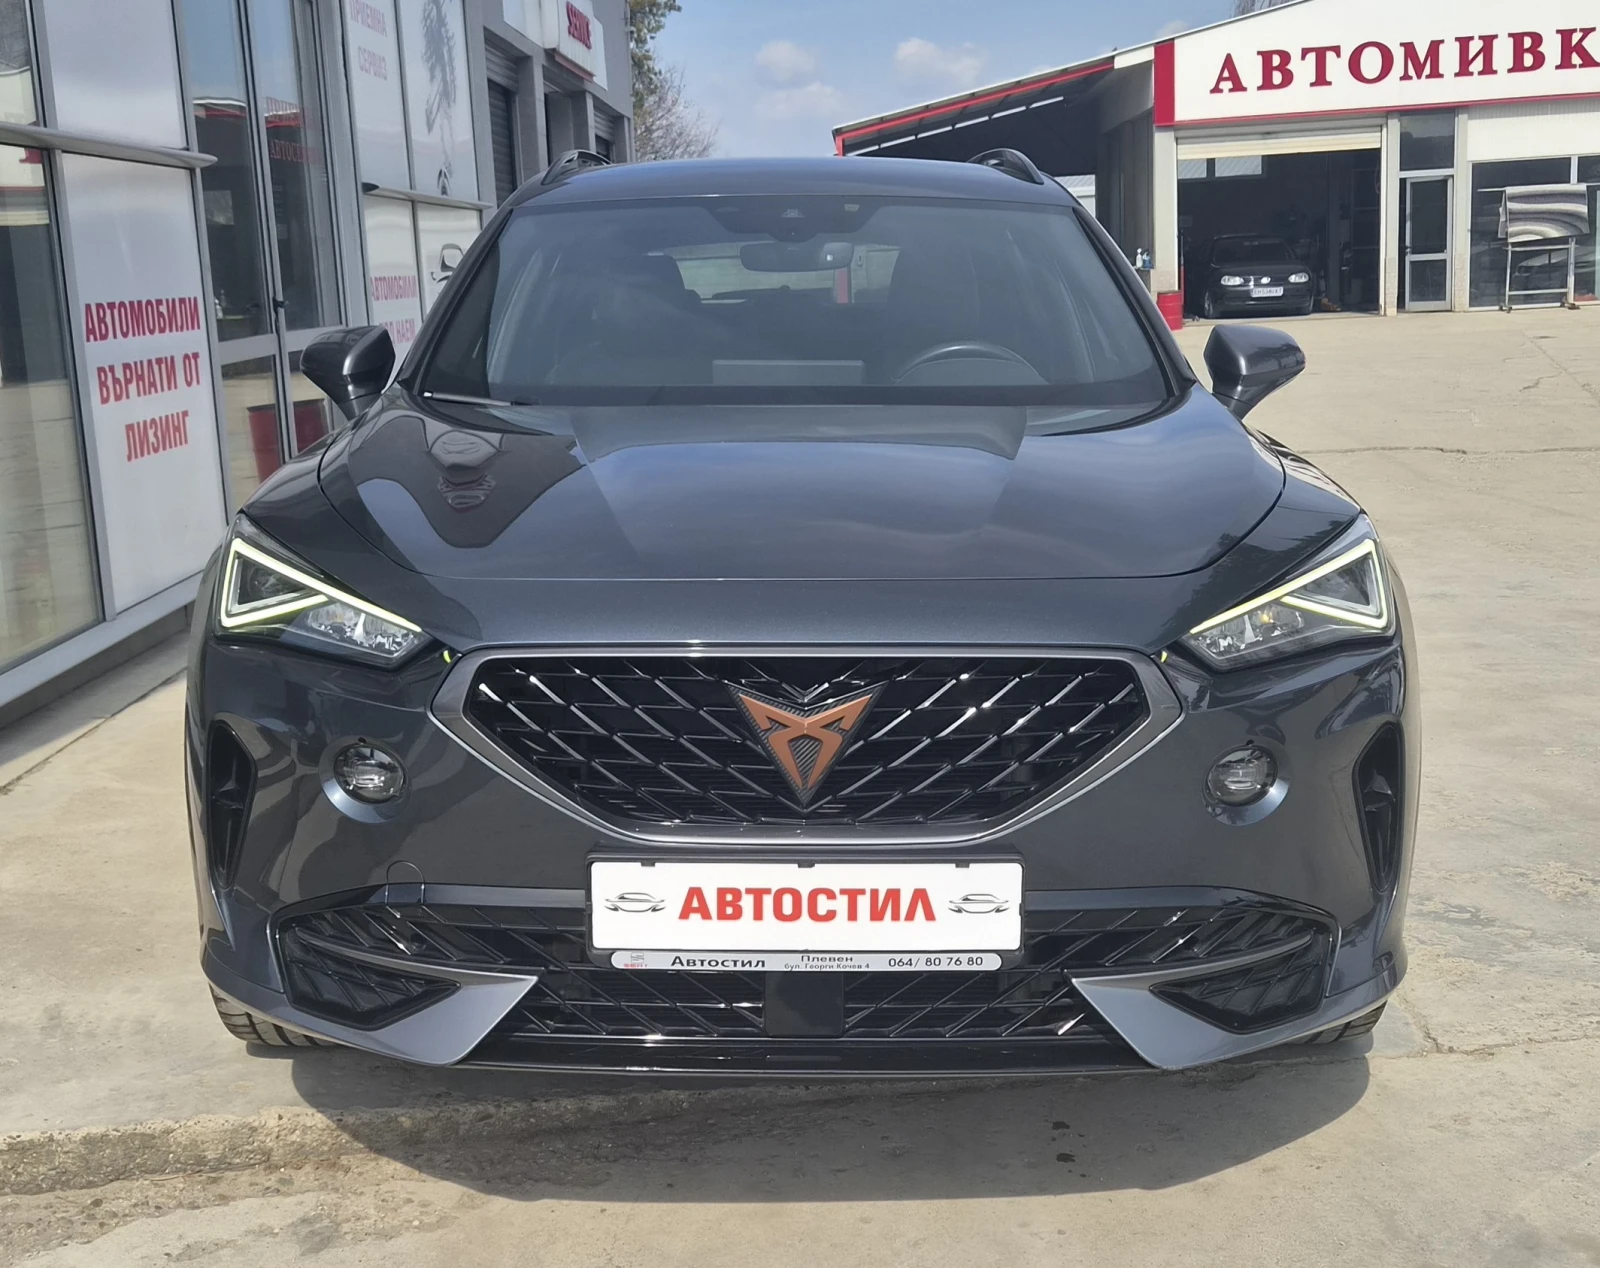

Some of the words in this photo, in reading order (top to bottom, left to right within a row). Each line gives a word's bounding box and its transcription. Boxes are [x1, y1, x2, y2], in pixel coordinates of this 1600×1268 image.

[1209, 26, 1600, 94] АВТОМИВК
[84, 296, 201, 343] АВТОМОБИЛИ
[96, 355, 178, 405] ВЪРНАТИ
[182, 352, 200, 388] ОТ
[125, 410, 189, 462] ЛИЗИНГ
[678, 886, 936, 922] АВТОСТИЛ
[670, 956, 766, 969] Автостил
[801, 954, 853, 963] Плевен
[804, 963, 834, 971] Георги
[888, 957, 921, 968] 064/
[925, 957, 942, 967] 80
[946, 956, 963, 967] 76
[966, 956, 984, 966] 80
